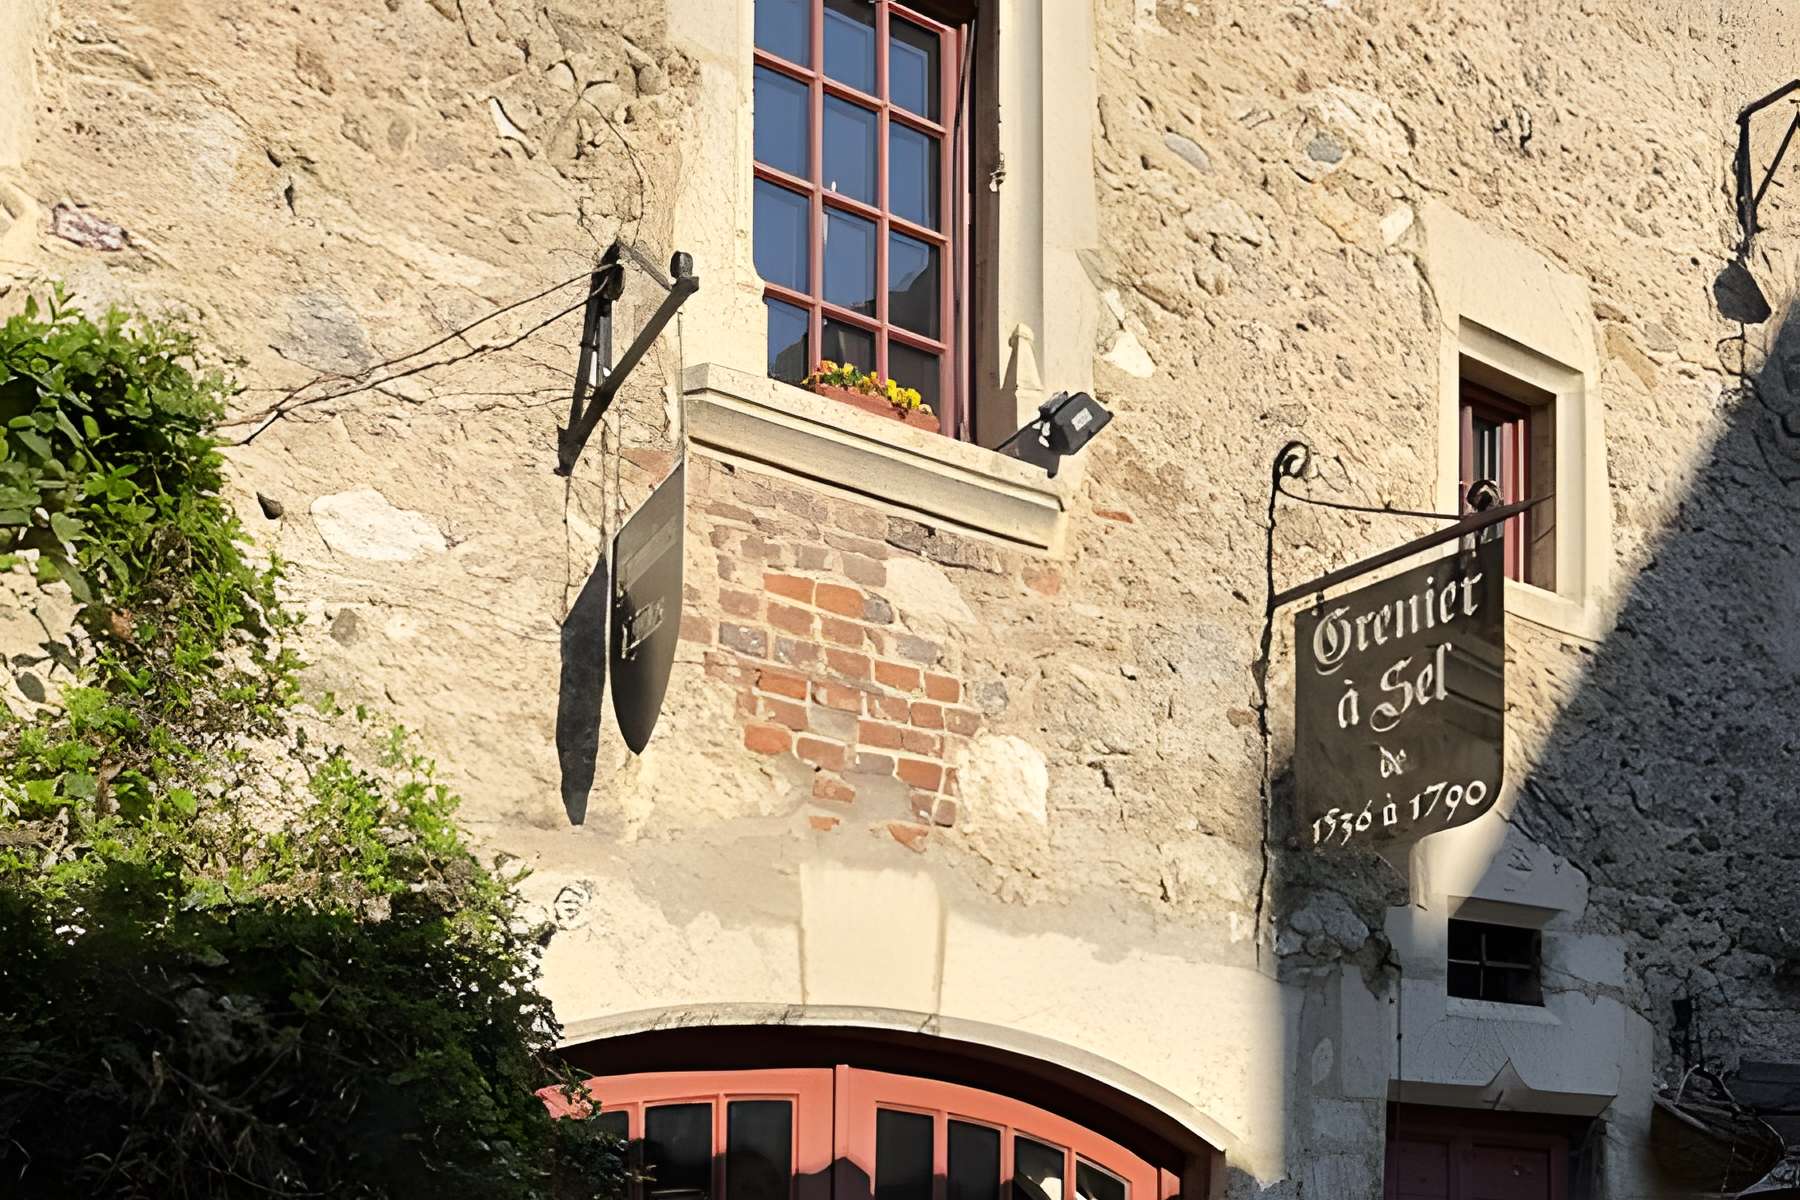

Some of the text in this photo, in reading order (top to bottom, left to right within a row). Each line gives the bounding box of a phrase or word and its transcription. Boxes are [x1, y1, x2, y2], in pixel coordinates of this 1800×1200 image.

[1313, 573, 1483, 676] Grenier
[1370, 642, 1452, 732] Sel
[1409, 780, 1486, 821] 1790
